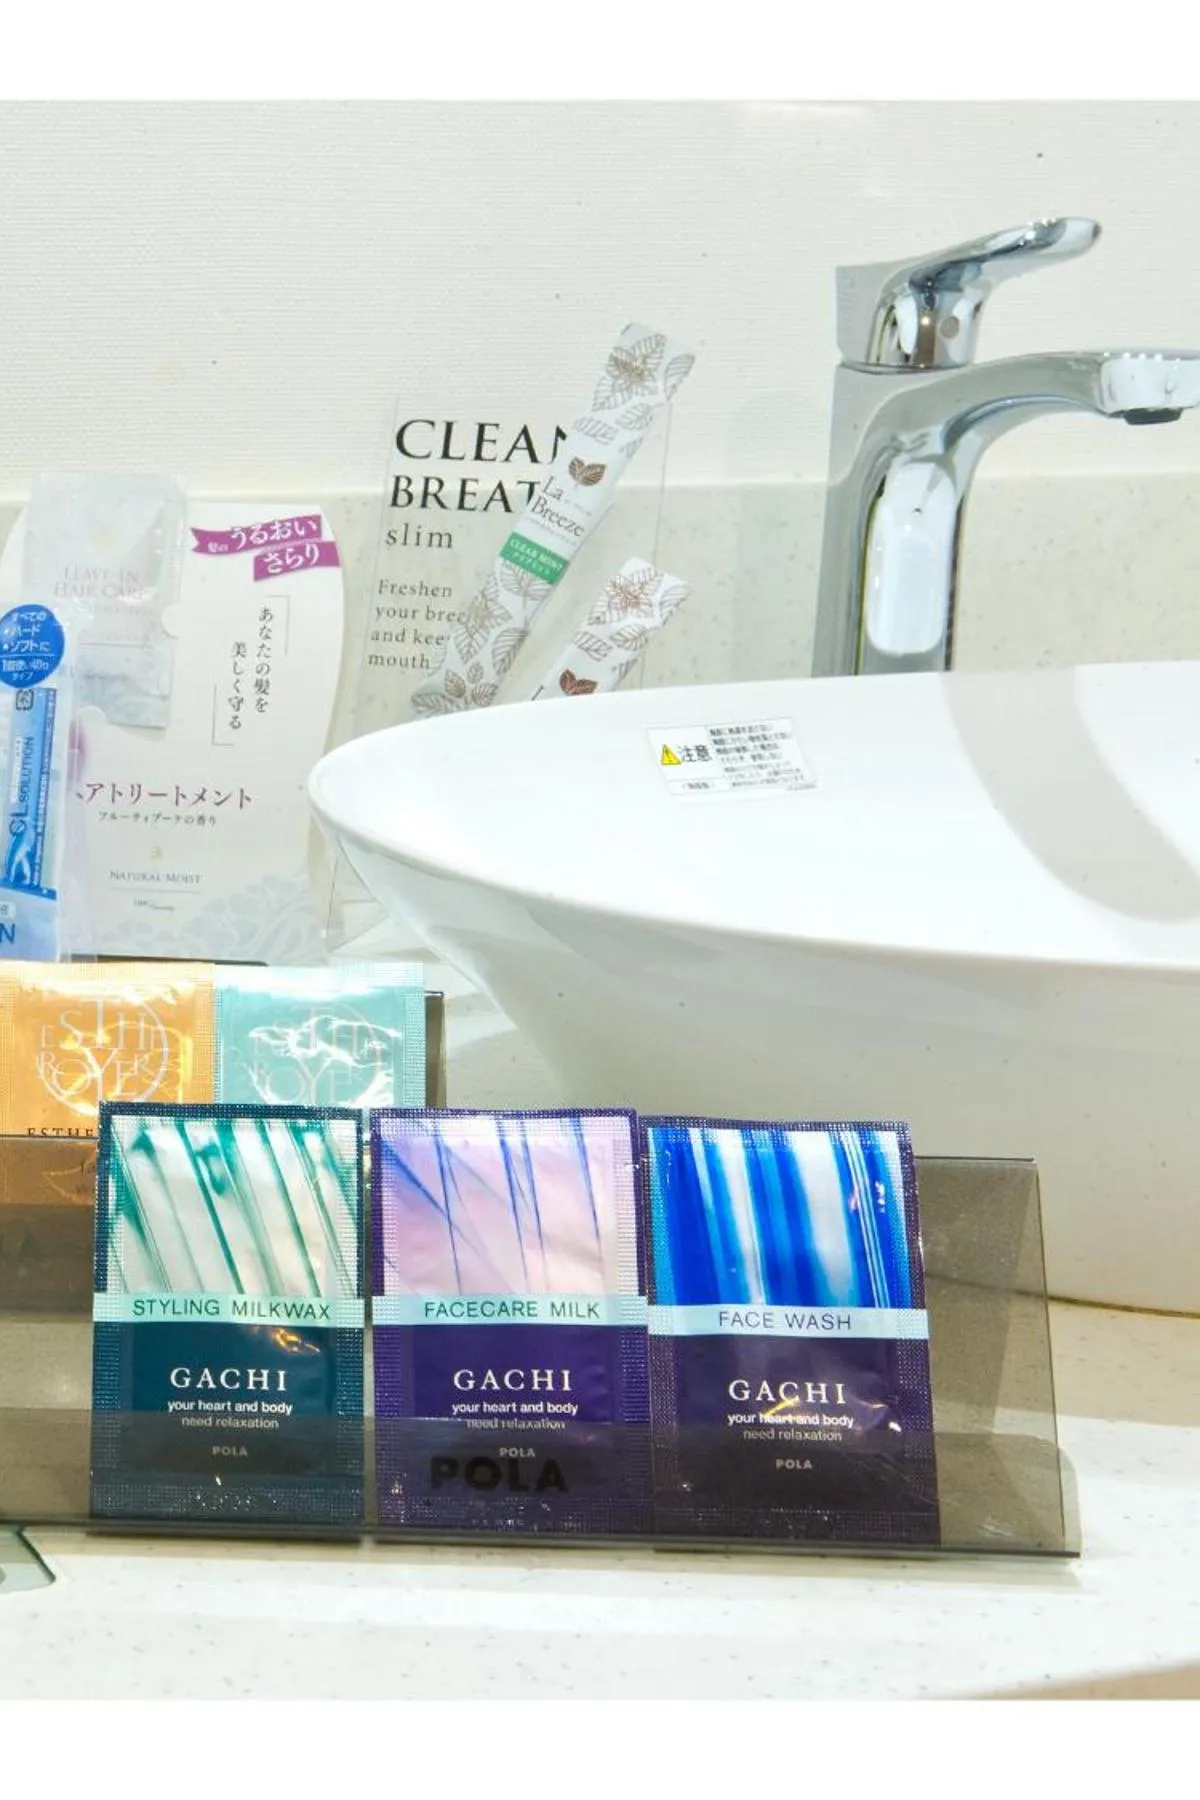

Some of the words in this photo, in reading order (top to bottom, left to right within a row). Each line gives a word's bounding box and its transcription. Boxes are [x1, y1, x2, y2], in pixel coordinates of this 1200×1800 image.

[532, 496, 585, 536] Breeze
[231, 520, 318, 548] うるおい
[385, 523, 453, 549] slim
[264, 543, 320, 574] さらり
[378, 579, 452, 599] Freshen
[374, 606, 419, 623] your
[370, 627, 406, 644] and
[413, 628, 450, 646] kee
[254, 607, 274, 714] あなたの髪を
[368, 652, 432, 670] mouth
[228, 641, 247, 730] 美しく守る
[18, 736, 35, 804] SOLUTION
[132, 1299, 220, 1317] STYLING
[232, 1301, 331, 1320] MILKWAX
[425, 1301, 538, 1319] FACECARE
[550, 1301, 601, 1319] MILK
[718, 1311, 775, 1329] FACE
[783, 1312, 852, 1330] WASH
[170, 1367, 288, 1392] GACHI
[453, 1369, 572, 1392] GACHI
[728, 1379, 846, 1404] GACHI
[167, 1401, 195, 1414] your
[198, 1400, 232, 1413] heart
[235, 1401, 260, 1413] and
[262, 1400, 293, 1416] body
[452, 1402, 479, 1415] your
[482, 1401, 516, 1414] heart
[520, 1401, 544, 1414] and
[547, 1401, 578, 1416] body
[181, 1416, 213, 1428] need
[215, 1416, 279, 1430] relaxation
[727, 1413, 756, 1427] your
[759, 1412, 793, 1426] heart
[797, 1412, 820, 1425] and
[822, 1413, 854, 1428] body
[743, 1429, 775, 1441] need
[778, 1429, 842, 1442] relaxation
[212, 1446, 248, 1457] POLA
[499, 1447, 536, 1458] POLA
[775, 1459, 813, 1469] POLA
[430, 1457, 568, 1493] POLA
